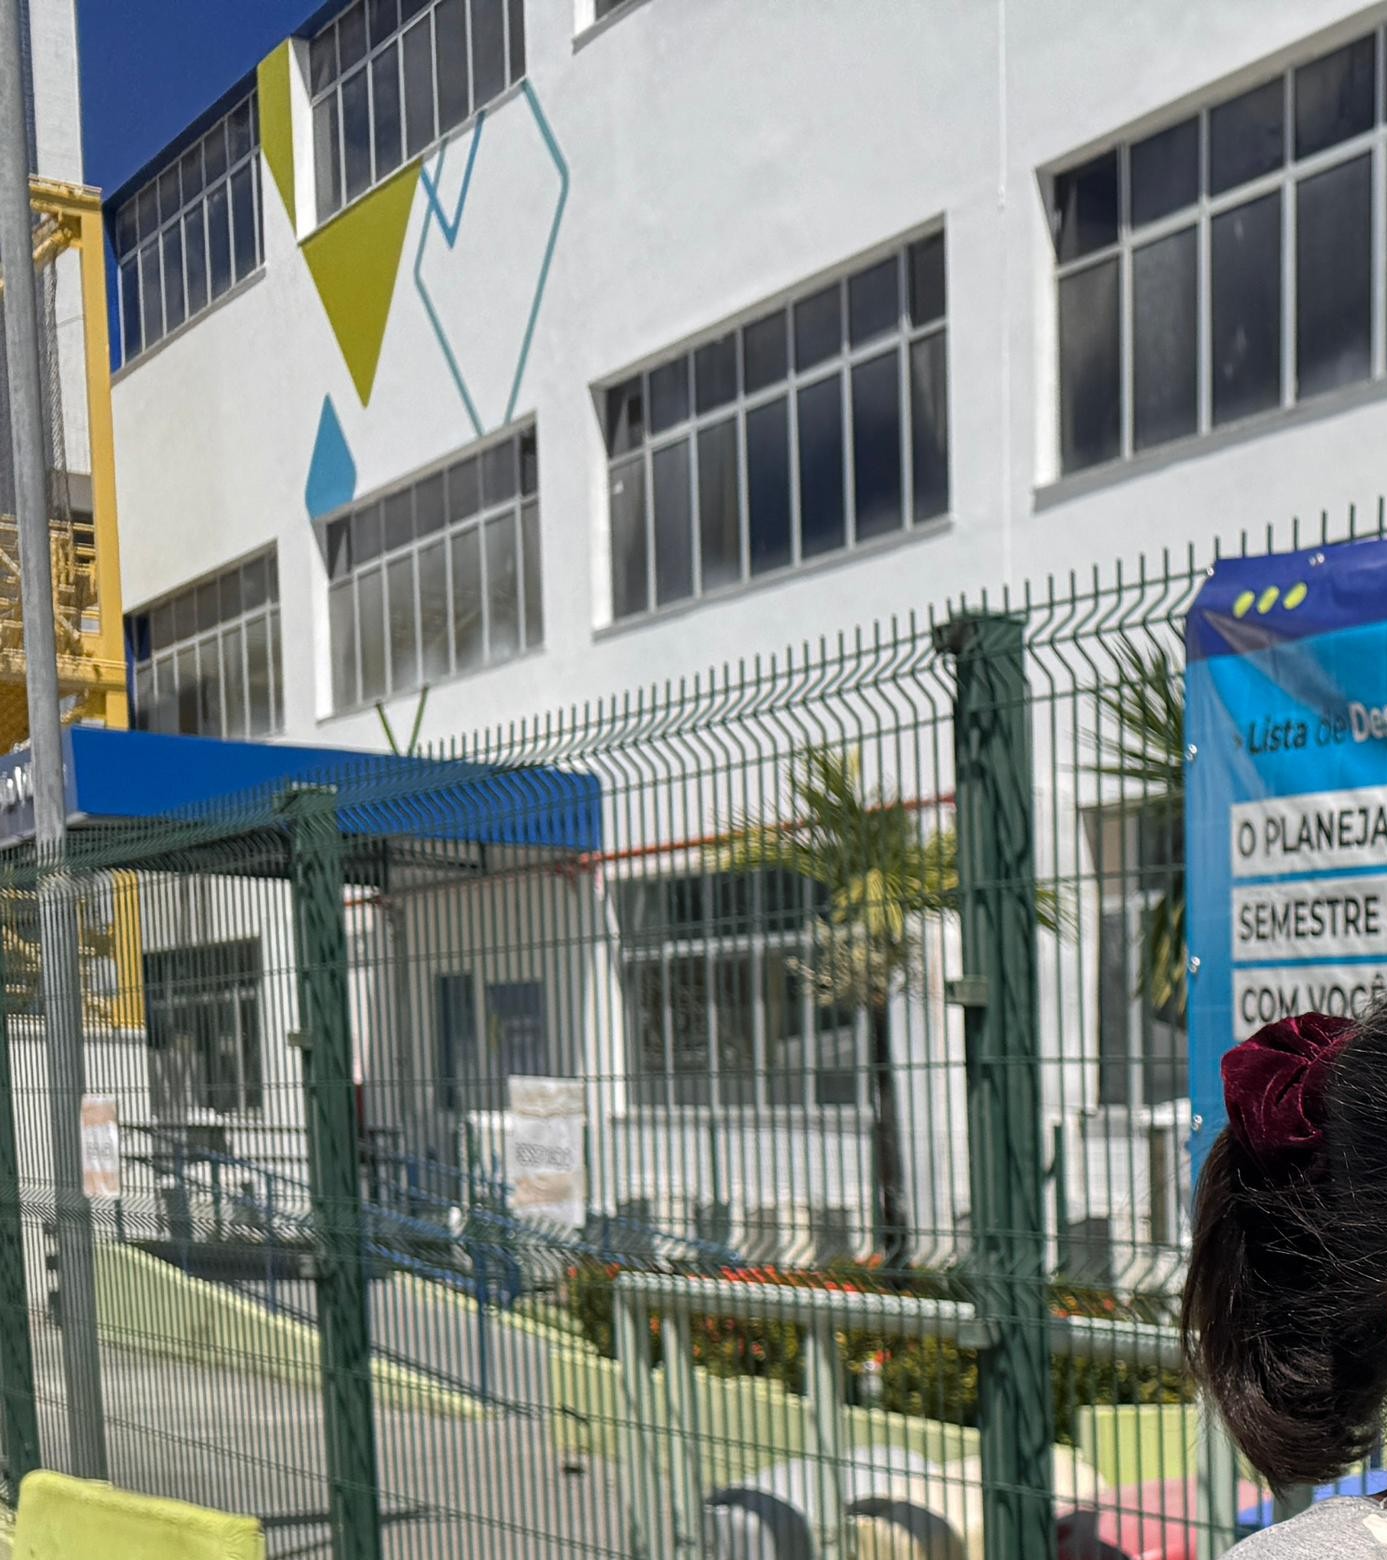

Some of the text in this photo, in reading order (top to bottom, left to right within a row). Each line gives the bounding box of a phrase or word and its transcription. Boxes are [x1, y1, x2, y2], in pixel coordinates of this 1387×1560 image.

[1248, 715, 1307, 754] Lista
[1314, 713, 1347, 747] de
[1239, 819, 1256, 857] O
[1240, 895, 1379, 942] SEMESTRE
[1242, 985, 1299, 1023] COM
